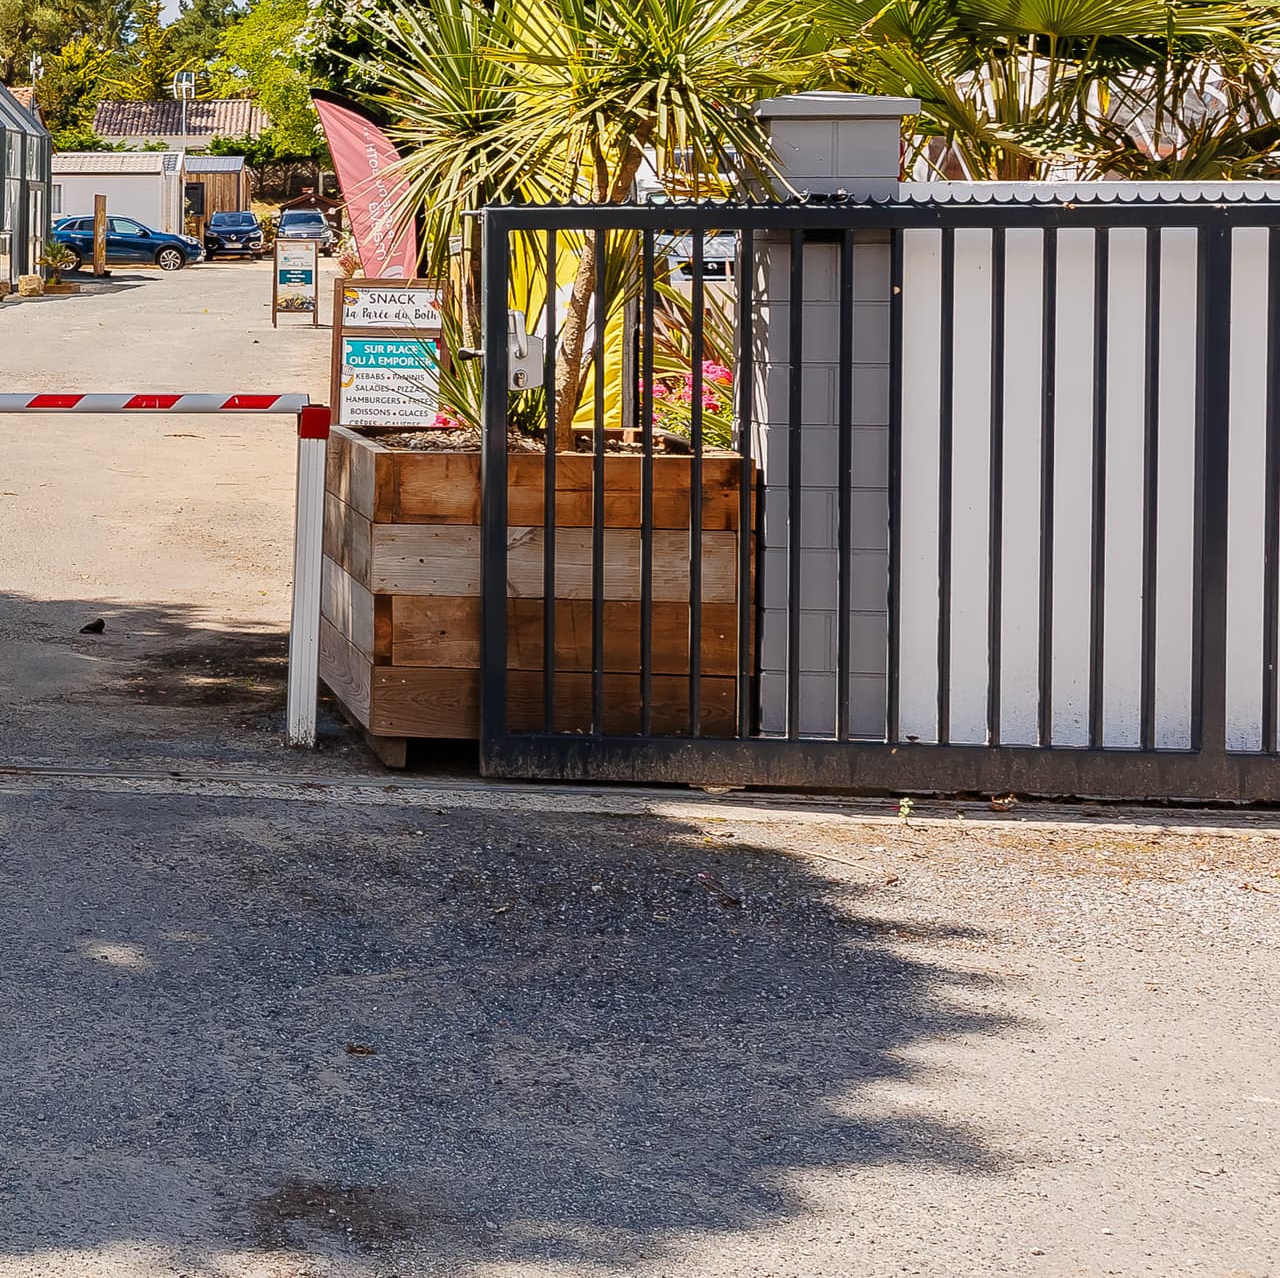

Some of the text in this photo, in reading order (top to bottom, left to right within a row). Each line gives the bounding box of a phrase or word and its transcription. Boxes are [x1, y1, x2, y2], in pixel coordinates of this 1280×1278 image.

[369, 293, 416, 305] SNACK
[394, 308, 409, 320] du
[364, 344, 419, 354] SUR PLACE
[349, 355, 366, 365] OU
[367, 353, 377, 365] À
[355, 372, 385, 380] KEBABS
[354, 384, 390, 392] SALADES
[345, 395, 401, 404] HAMBURGERS
[350, 407, 429, 417] BOISSONS GLACES
